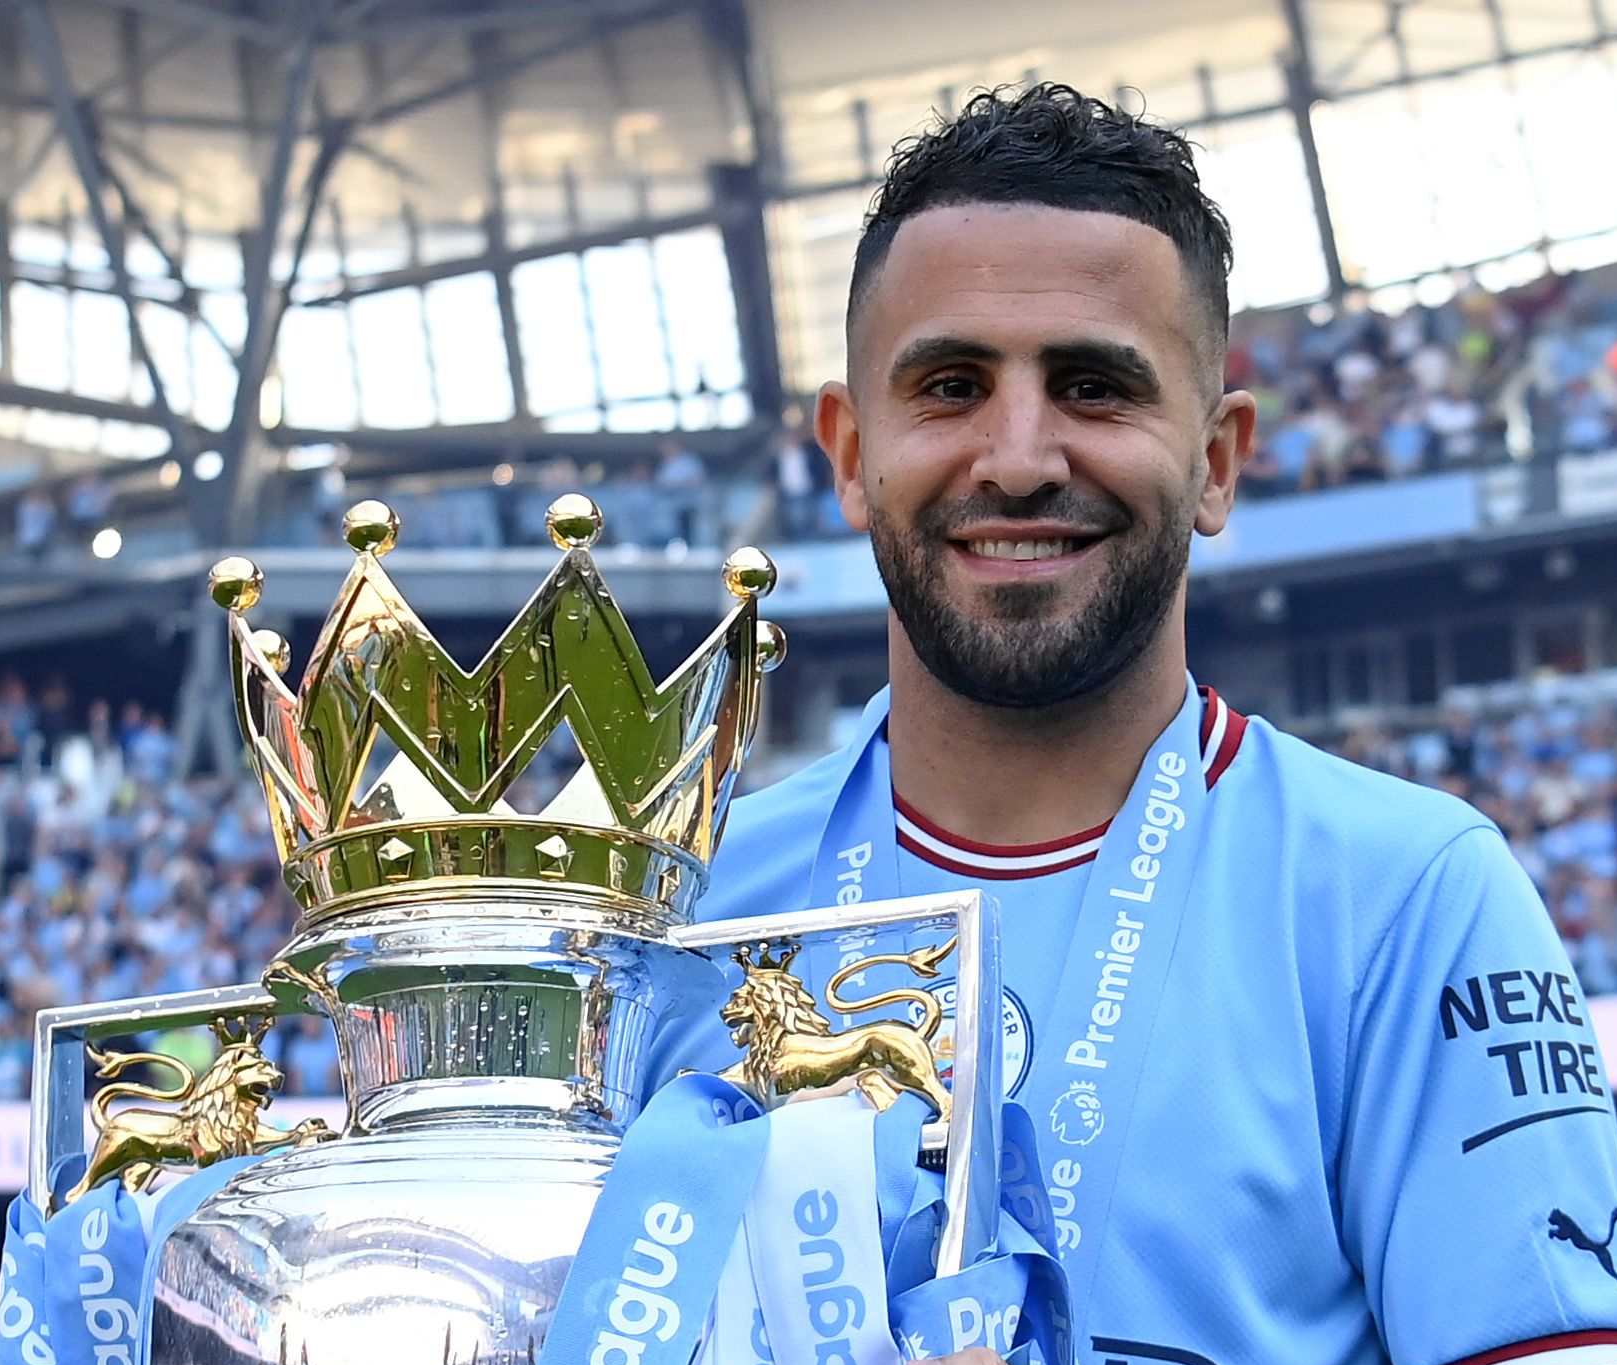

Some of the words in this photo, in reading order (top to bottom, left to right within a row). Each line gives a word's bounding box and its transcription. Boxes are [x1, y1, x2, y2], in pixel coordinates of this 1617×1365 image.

[836, 841, 876, 988] Preier
[1065, 911, 1145, 1069] Premier
[1110, 751, 1187, 903] League
[1439, 970, 1584, 1040] NEXE
[1486, 1040, 1604, 1097] TIRE
[1051, 1158, 1082, 1258] gue
